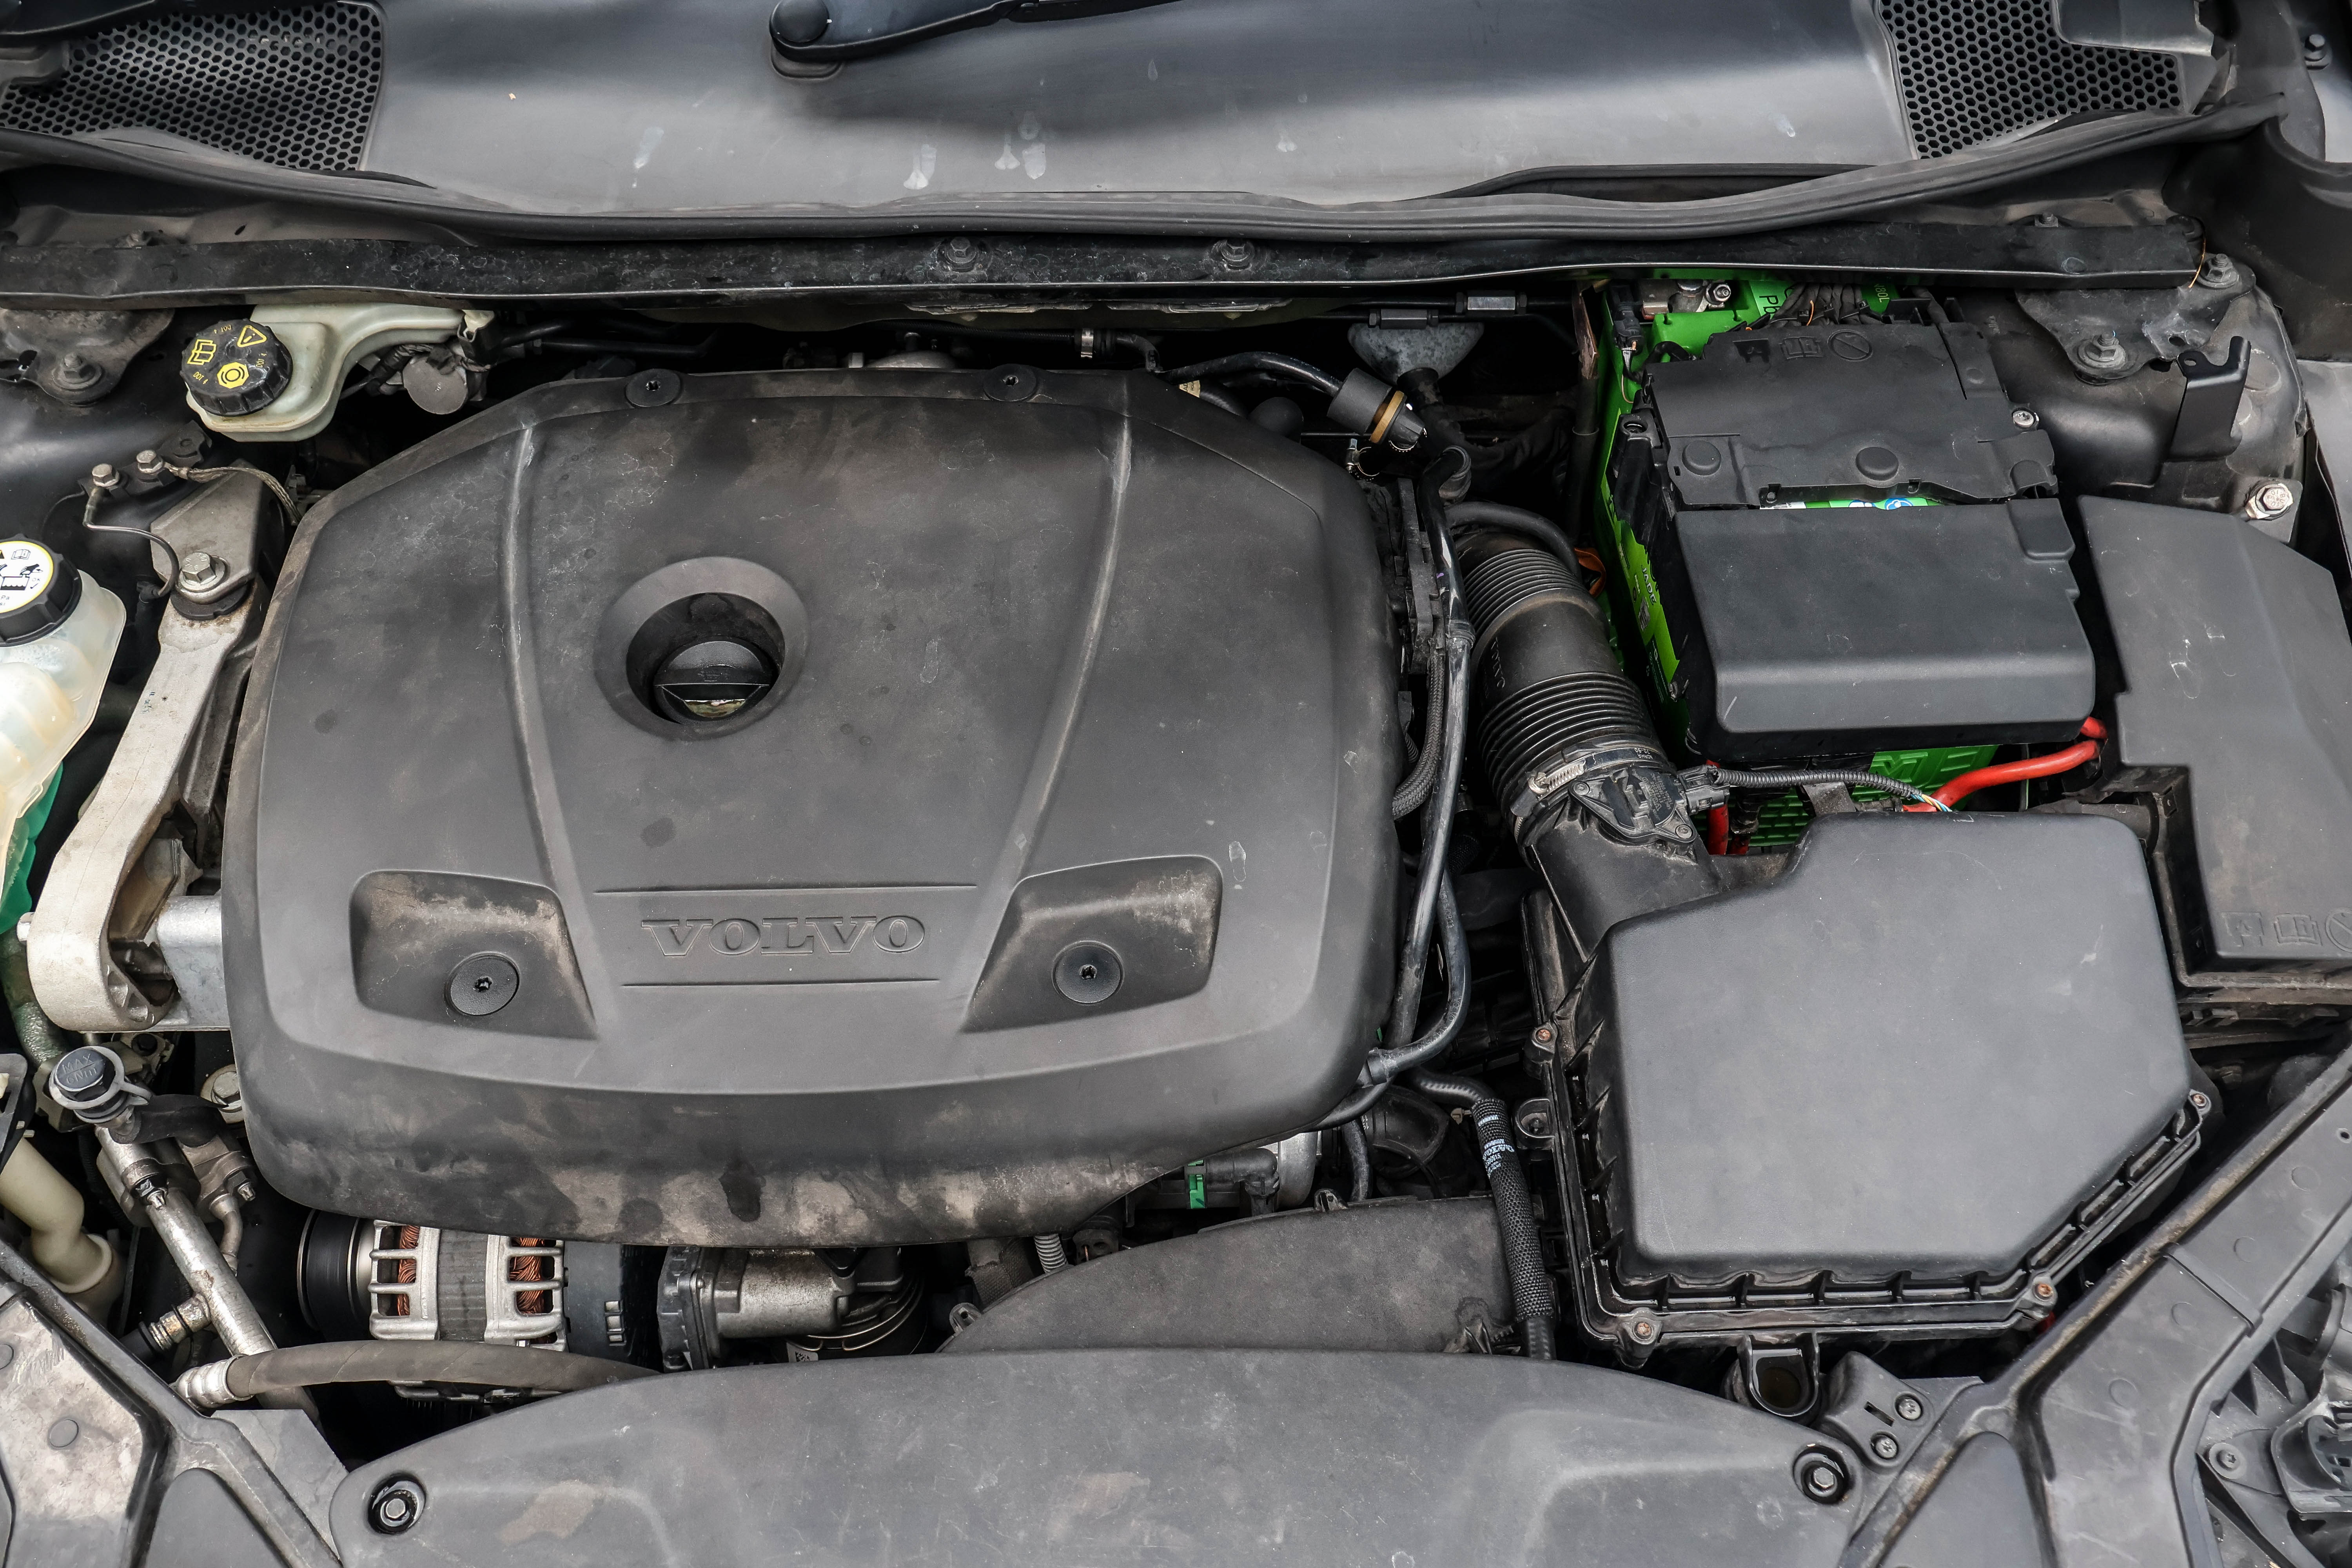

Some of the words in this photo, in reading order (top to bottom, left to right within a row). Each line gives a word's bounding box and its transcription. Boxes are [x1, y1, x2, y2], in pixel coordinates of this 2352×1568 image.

[256, 359, 265, 368] DOT
[193, 372, 205, 381] DOT
[1642, 777, 1662, 811] VOLVO
[641, 915, 926, 956] VOLVO
[62, 1054, 94, 1073] MAX
